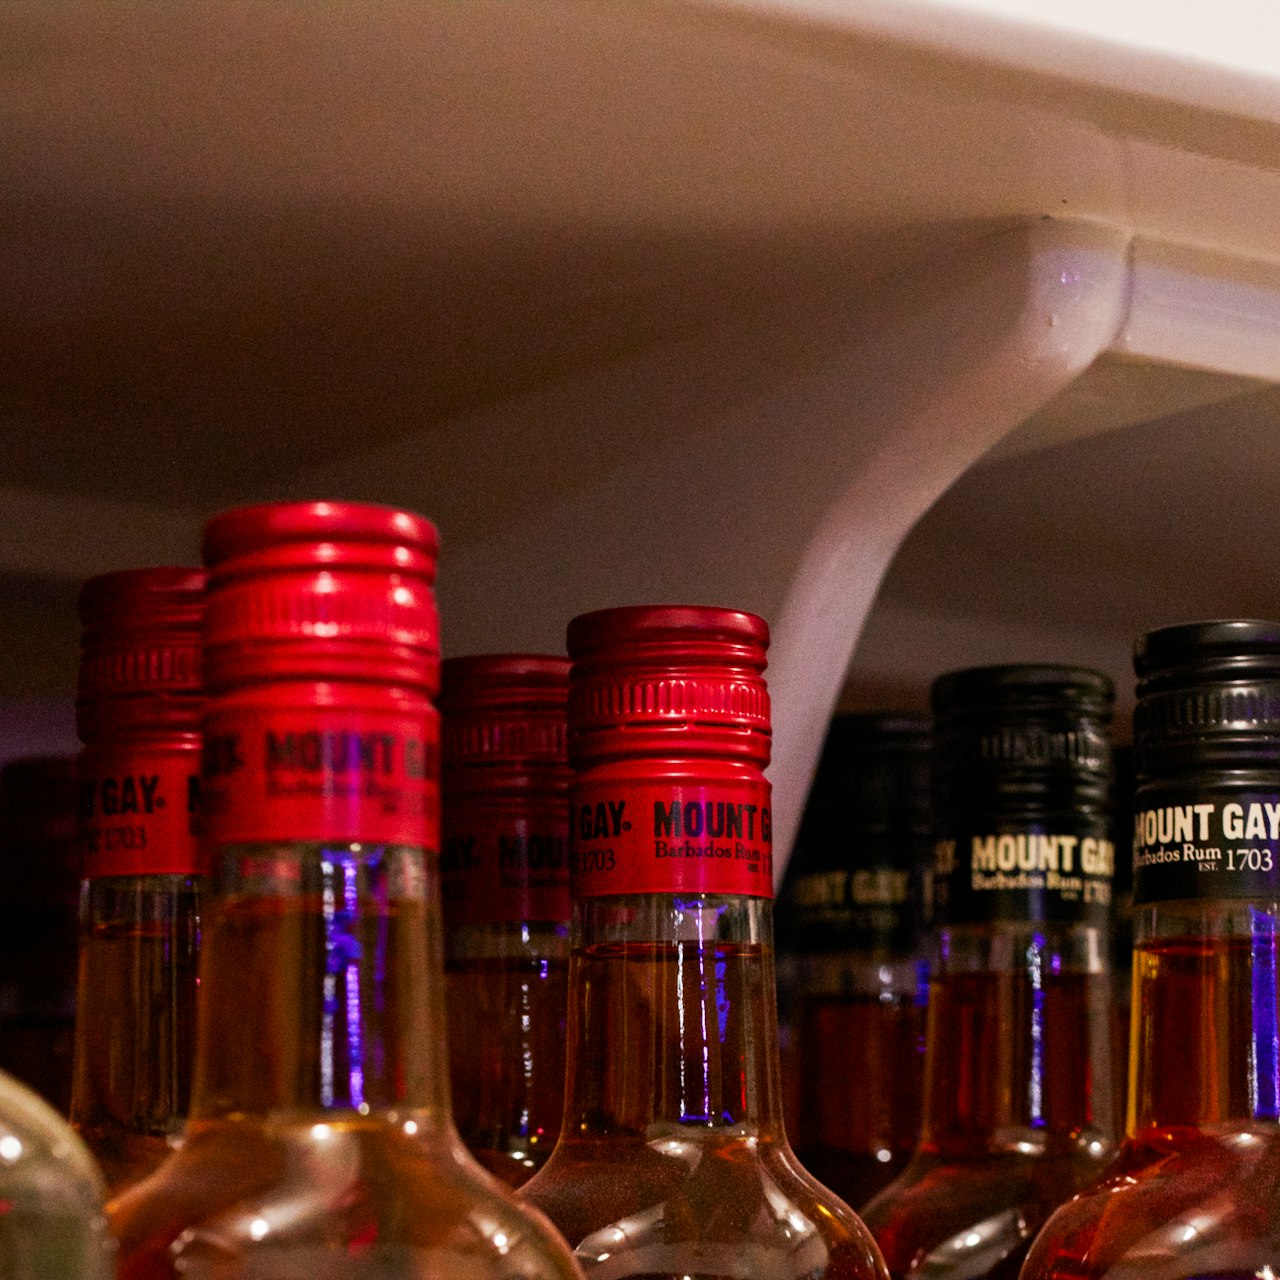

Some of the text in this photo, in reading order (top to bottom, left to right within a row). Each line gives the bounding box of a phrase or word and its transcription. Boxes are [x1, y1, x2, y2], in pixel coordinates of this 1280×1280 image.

[654, 800, 766, 839] MOUNT
[654, 840, 732, 858] Barbados
[971, 834, 1078, 872] MOUNT
[1182, 842, 1222, 862] Rum
[1226, 849, 1274, 872] 1703
